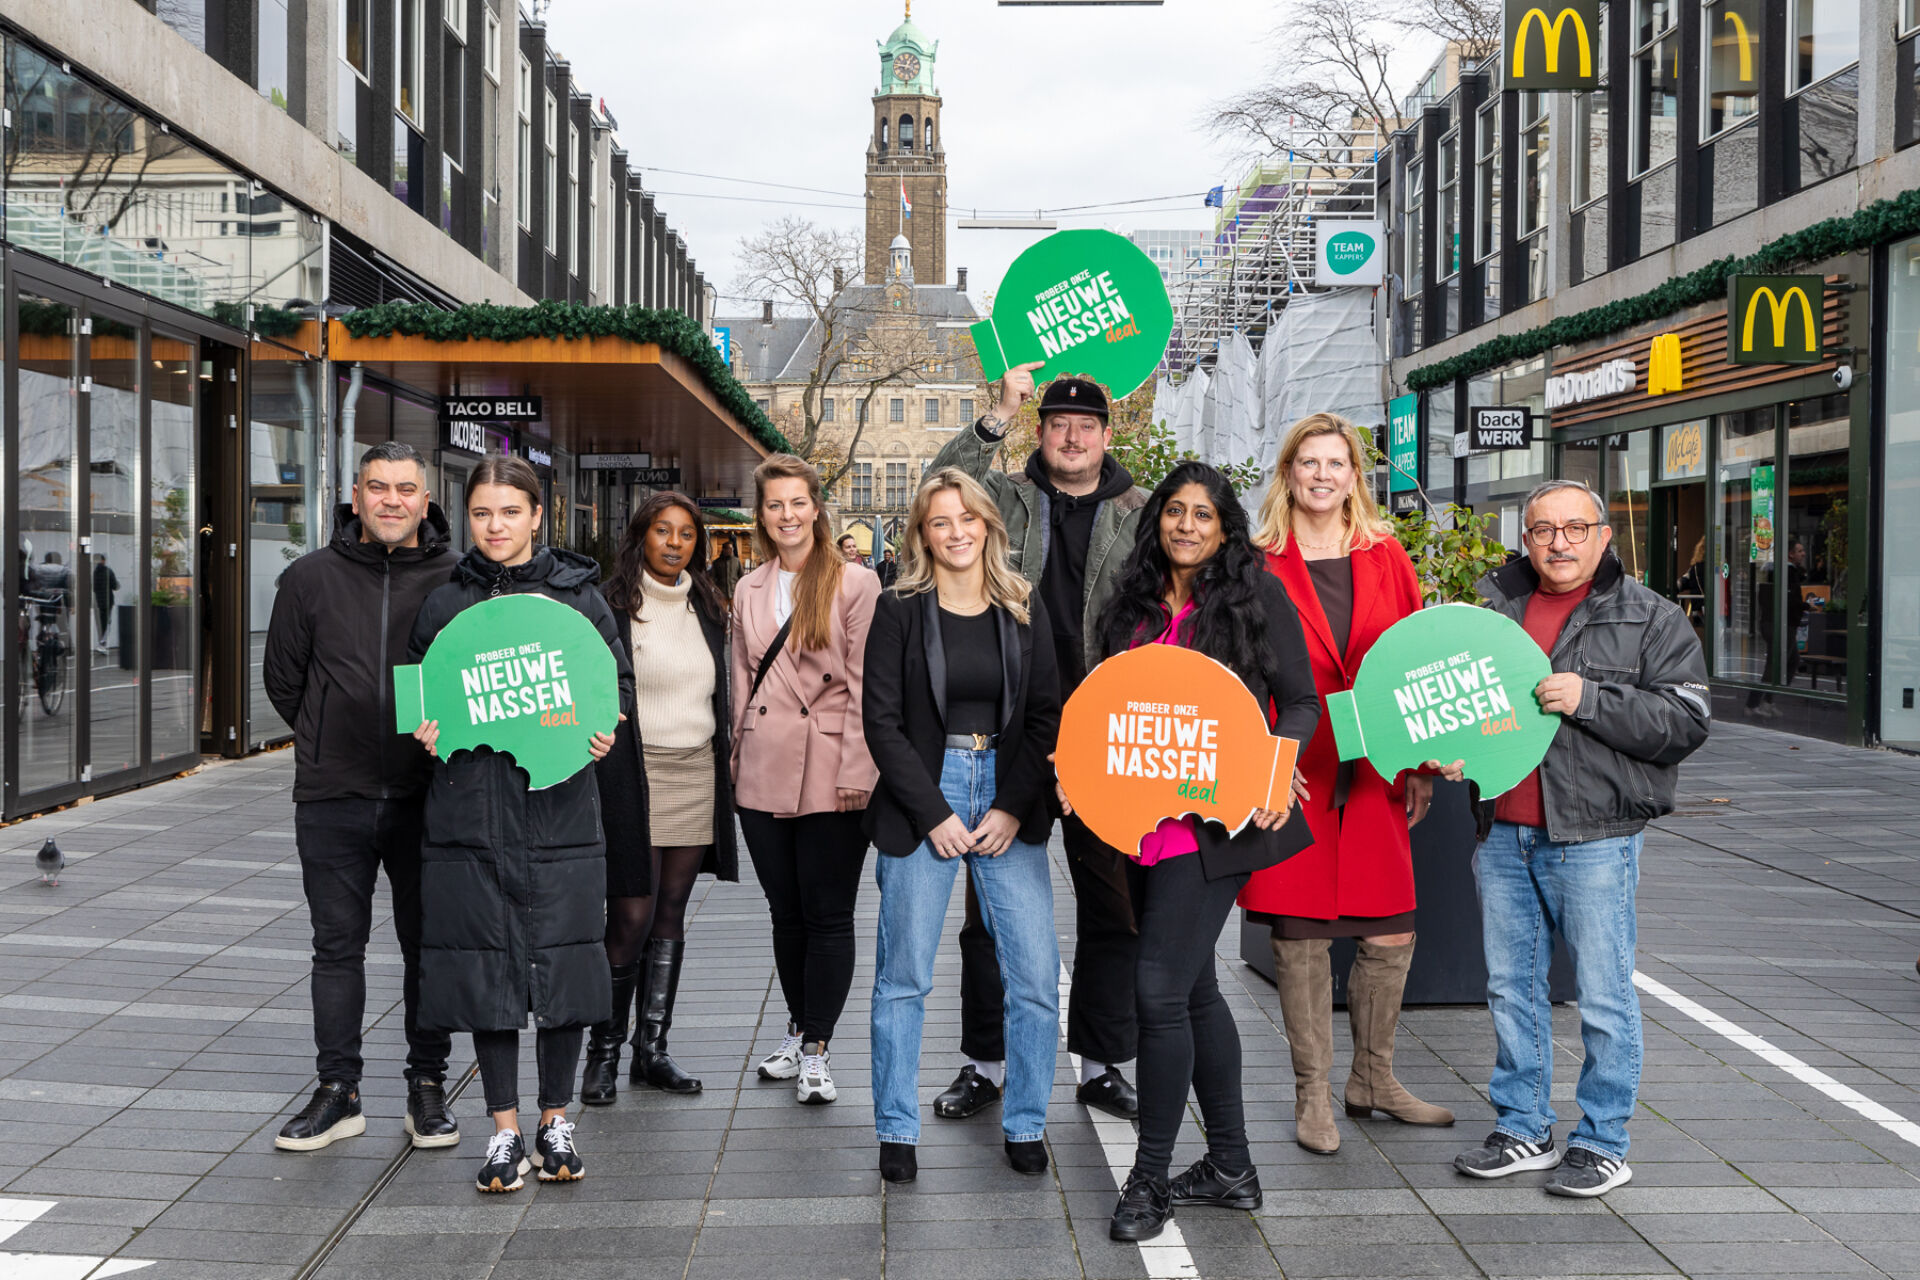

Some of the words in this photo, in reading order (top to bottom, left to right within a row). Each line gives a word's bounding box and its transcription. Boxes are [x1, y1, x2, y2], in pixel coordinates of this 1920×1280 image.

[1332, 242, 1364, 252] TEAM
[1035, 280, 1070, 304] PROBEER
[1070, 269, 1091, 285] ONZE
[1026, 270, 1118, 335] NIEUWE
[1038, 295, 1131, 359] NASSEN
[1105, 313, 1141, 344] deal
[1545, 359, 1636, 409] McDonald's
[446, 401, 491, 416] TACO
[495, 401, 537, 416] BELL
[1481, 412, 1521, 427] back
[469, 421, 487, 455] BELL
[1393, 412, 1416, 446] TEAM
[1477, 430, 1524, 446] WERK
[634, 471, 669, 483] ZUMO
[1395, 451, 1416, 472] KAPPERS
[475, 647, 515, 664] PROBEER
[518, 642, 542, 654] ONZE
[1405, 661, 1445, 682] PROBEER
[1447, 651, 1471, 667] ONZE
[461, 650, 567, 696] NIEUWE
[1393, 656, 1501, 715] NIEUWE
[467, 679, 573, 725] NASSEN
[540, 701, 580, 728] deal
[1127, 701, 1170, 714] PROBEER
[1173, 704, 1199, 716] ONZE
[1404, 685, 1512, 744] NASSEN
[1108, 713, 1219, 749] NIEUWE
[1481, 706, 1521, 736] deal
[1106, 746, 1217, 782] NASSEN
[1177, 774, 1219, 805] deal
